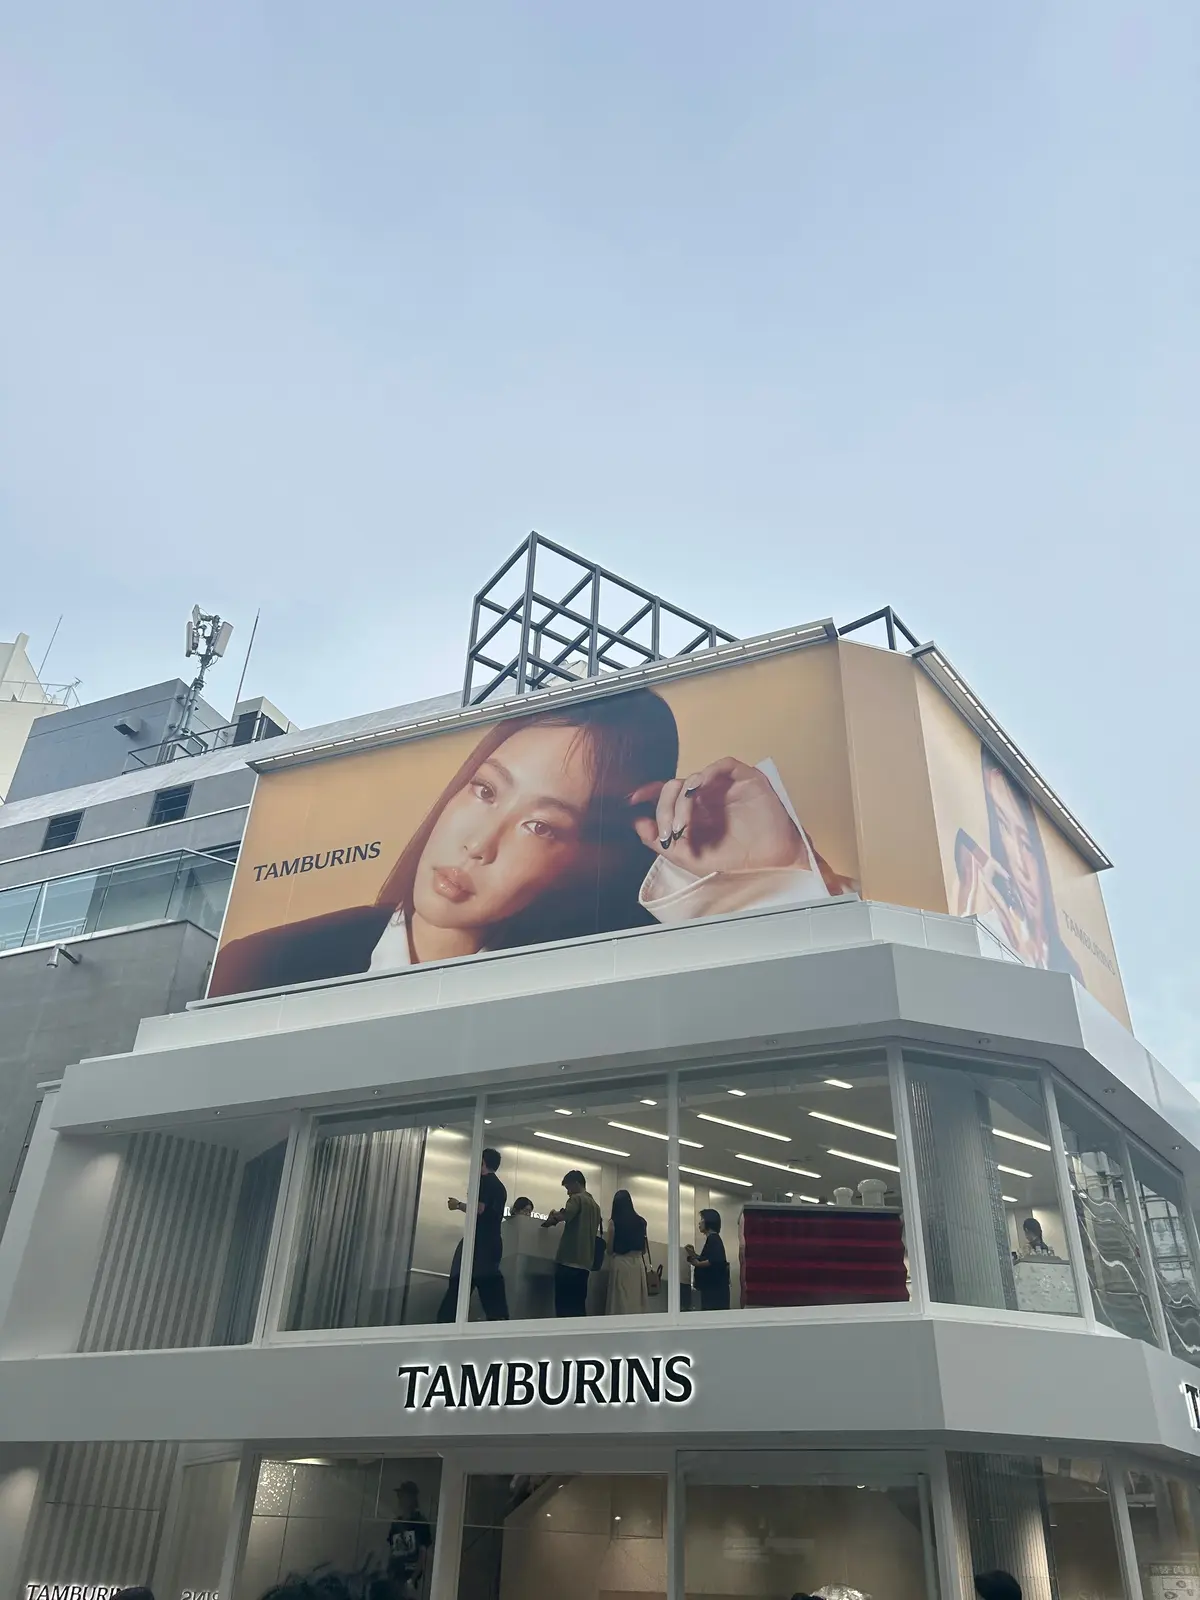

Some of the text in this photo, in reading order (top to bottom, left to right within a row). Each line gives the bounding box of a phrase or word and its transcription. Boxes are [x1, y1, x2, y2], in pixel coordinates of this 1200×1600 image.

[253, 841, 381, 882] TAMBURINS
[398, 1355, 693, 1409] TAMBURINS
[27, 1584, 121, 1600] TAMBURI
